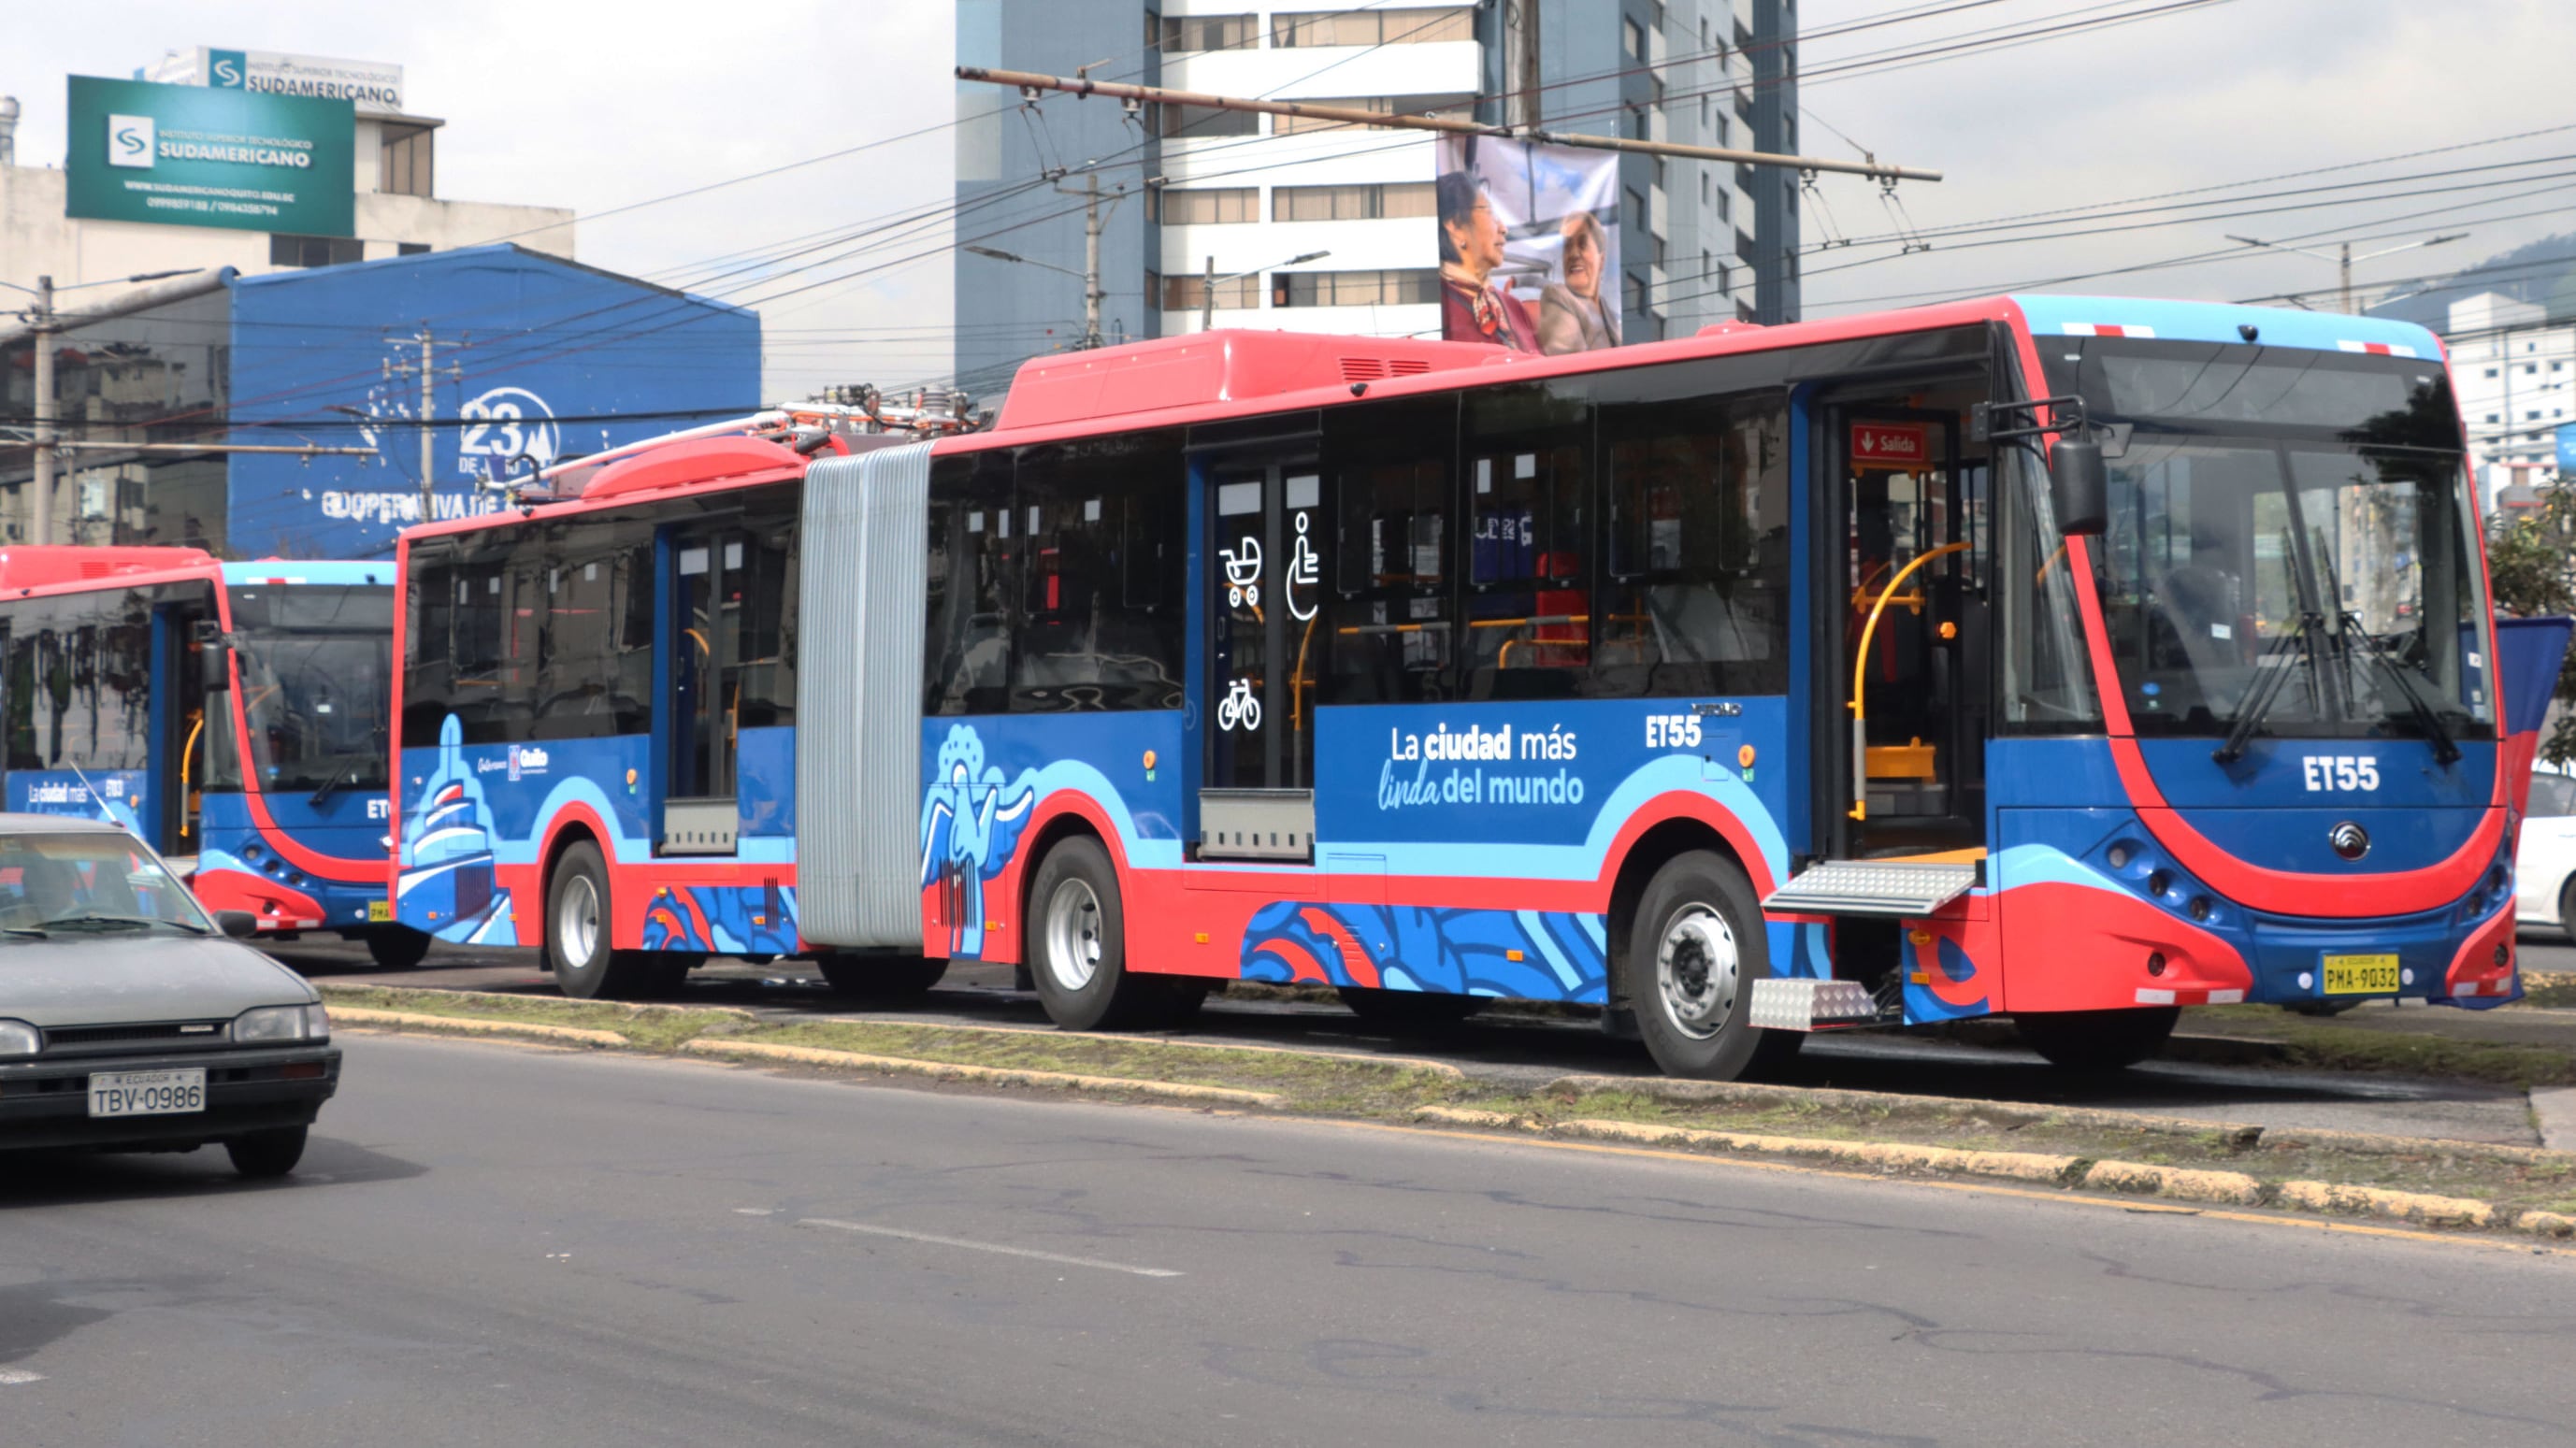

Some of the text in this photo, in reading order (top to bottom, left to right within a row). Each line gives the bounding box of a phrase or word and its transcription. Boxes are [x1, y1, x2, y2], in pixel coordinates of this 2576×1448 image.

[293, 65, 332, 78] SUPERIOR
[249, 76, 396, 104] SUDAMERICANO
[159, 129, 203, 140] INSTITUTO
[206, 132, 246, 144] SUPERIOR
[159, 142, 309, 167] SUDAMERICANO
[459, 402, 523, 456] 23
[1880, 436, 1915, 452] Salida
[458, 456, 475, 474] DE
[1392, 723, 1576, 760] La ciudad más
[1646, 714, 1702, 748] ET55
[1378, 757, 1584, 810] linda del mundo
[2303, 755, 2380, 791] ET55
[2326, 968, 2396, 989] PMA-9032
[95, 1085, 200, 1112] TBV-0986
